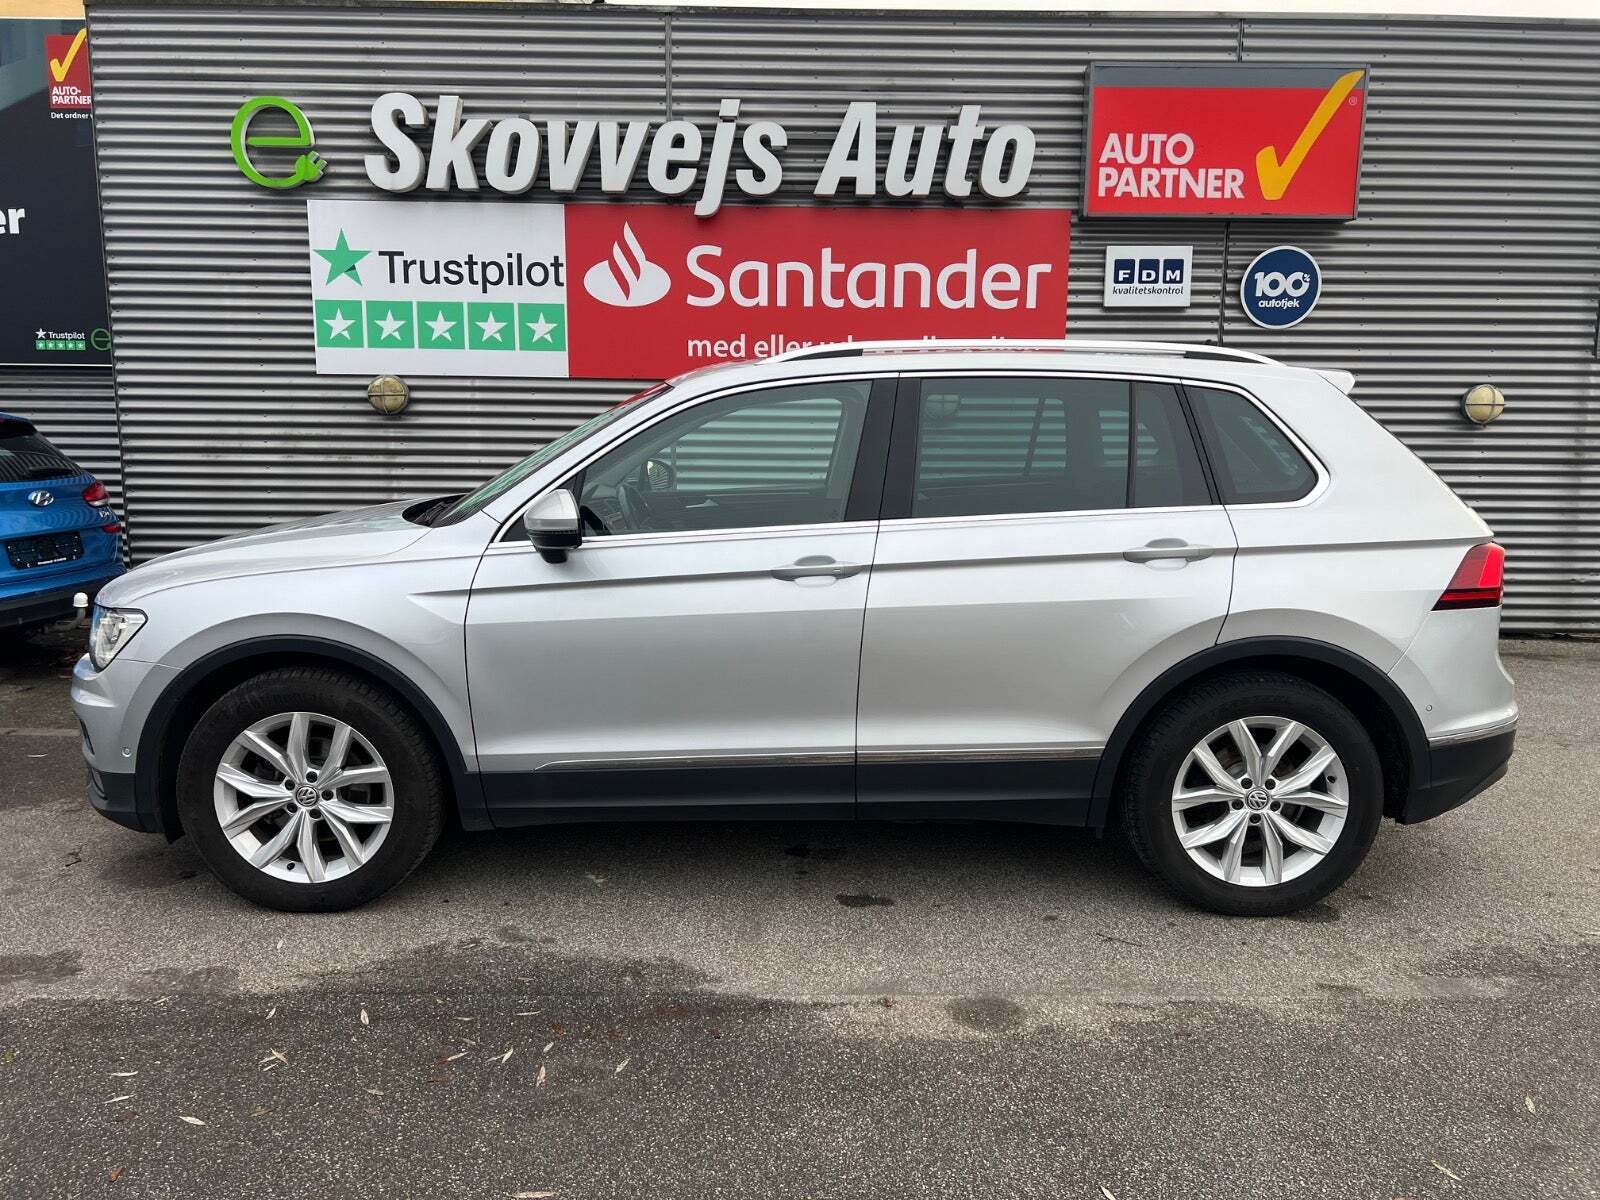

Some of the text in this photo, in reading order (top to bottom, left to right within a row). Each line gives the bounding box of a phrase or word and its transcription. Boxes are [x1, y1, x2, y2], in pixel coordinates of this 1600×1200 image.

[364, 91, 1037, 218] Skovvejs Auto
[1099, 132, 1195, 166] AUTO
[1098, 167, 1245, 199] PARTNER
[378, 250, 565, 294] Trustpilot
[685, 244, 1053, 311] Santander
[1112, 286, 1184, 295] kvalitetskontrol
[1258, 298, 1300, 310] autotjek
[48, 331, 86, 341] Trustpilot
[687, 334, 746, 358] med
